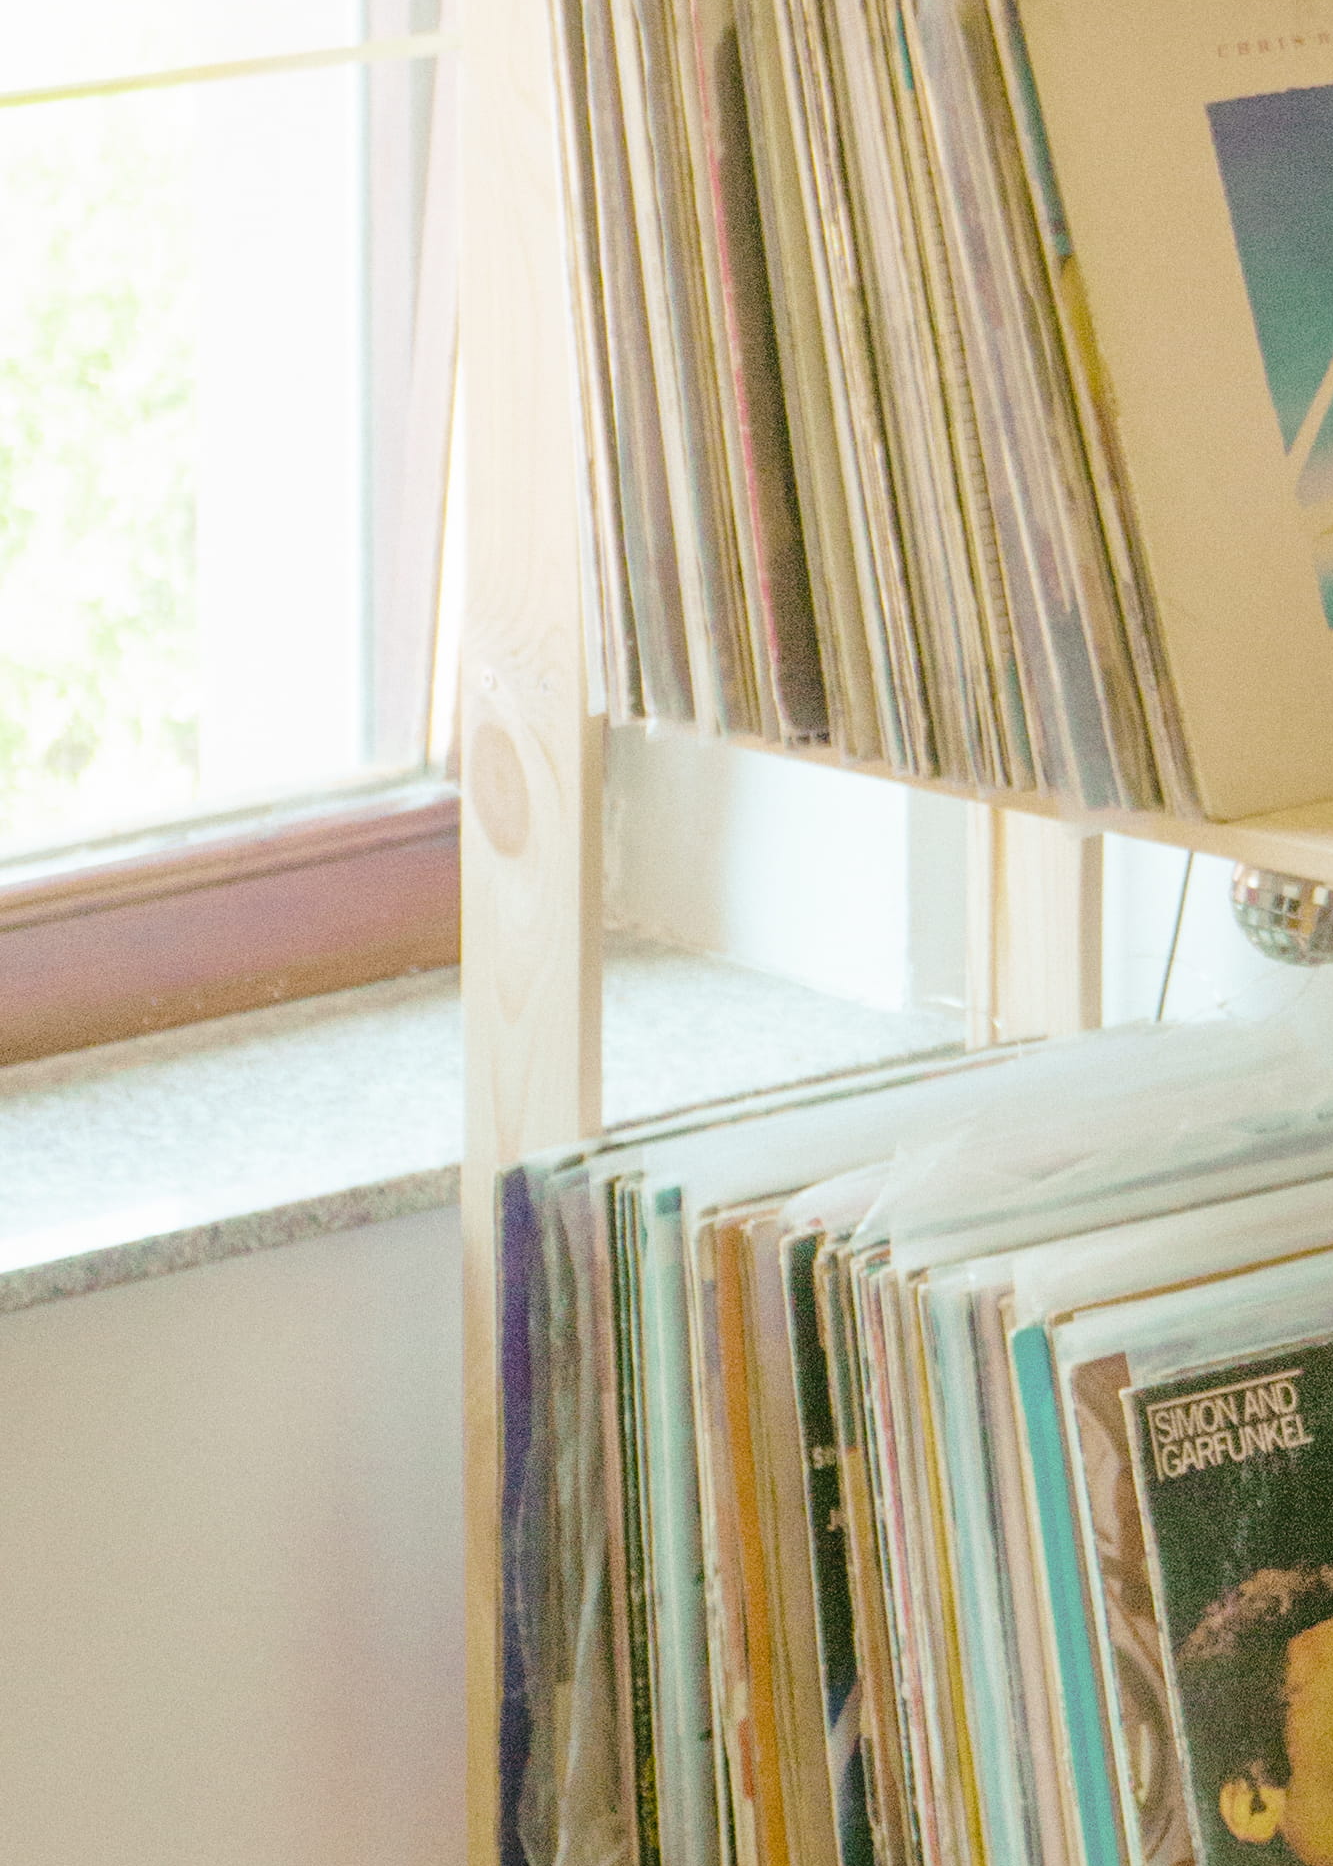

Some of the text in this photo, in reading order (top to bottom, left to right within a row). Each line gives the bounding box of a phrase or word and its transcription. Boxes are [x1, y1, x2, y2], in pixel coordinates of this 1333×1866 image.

[1155, 1382, 1298, 1445] SIMON AND
[1161, 1414, 1315, 1478] GARFUNKEL
